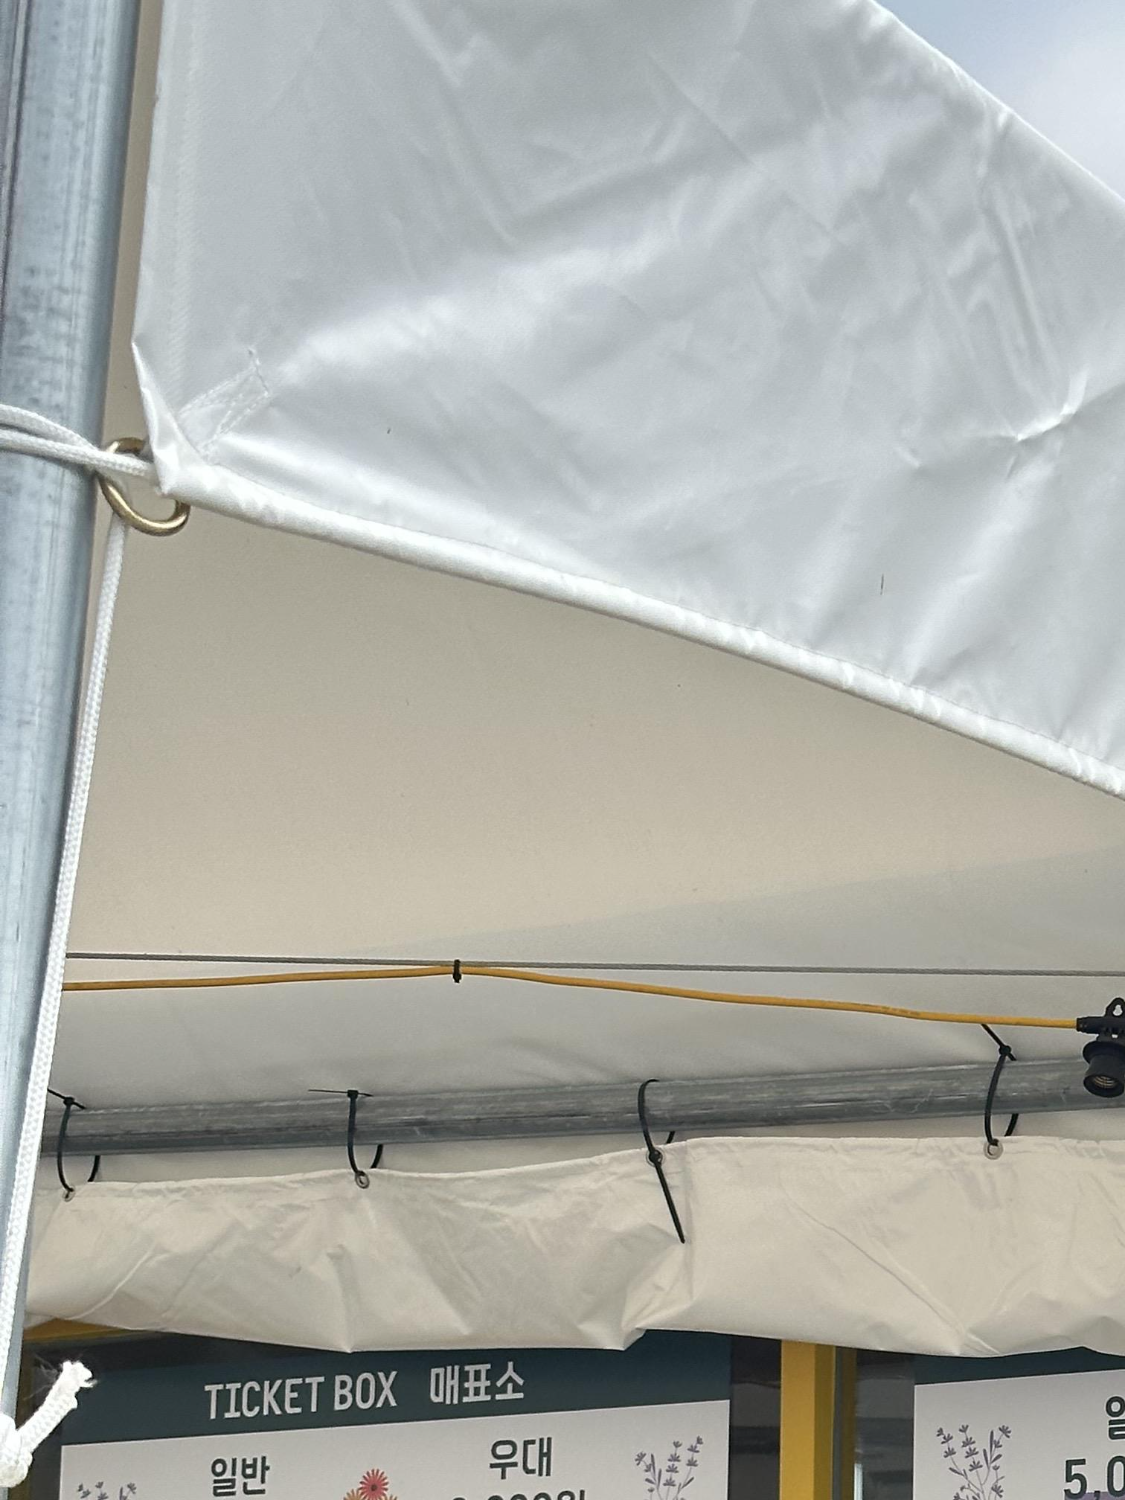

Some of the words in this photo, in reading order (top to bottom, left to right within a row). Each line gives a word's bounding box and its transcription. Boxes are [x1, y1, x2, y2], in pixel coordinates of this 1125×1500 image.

[204, 1377, 326, 1420] TICKET
[332, 1371, 398, 1413] BOX
[428, 1362, 525, 1405] 매표소
[209, 1455, 271, 1497] 일반
[489, 1437, 554, 1480] 우대
